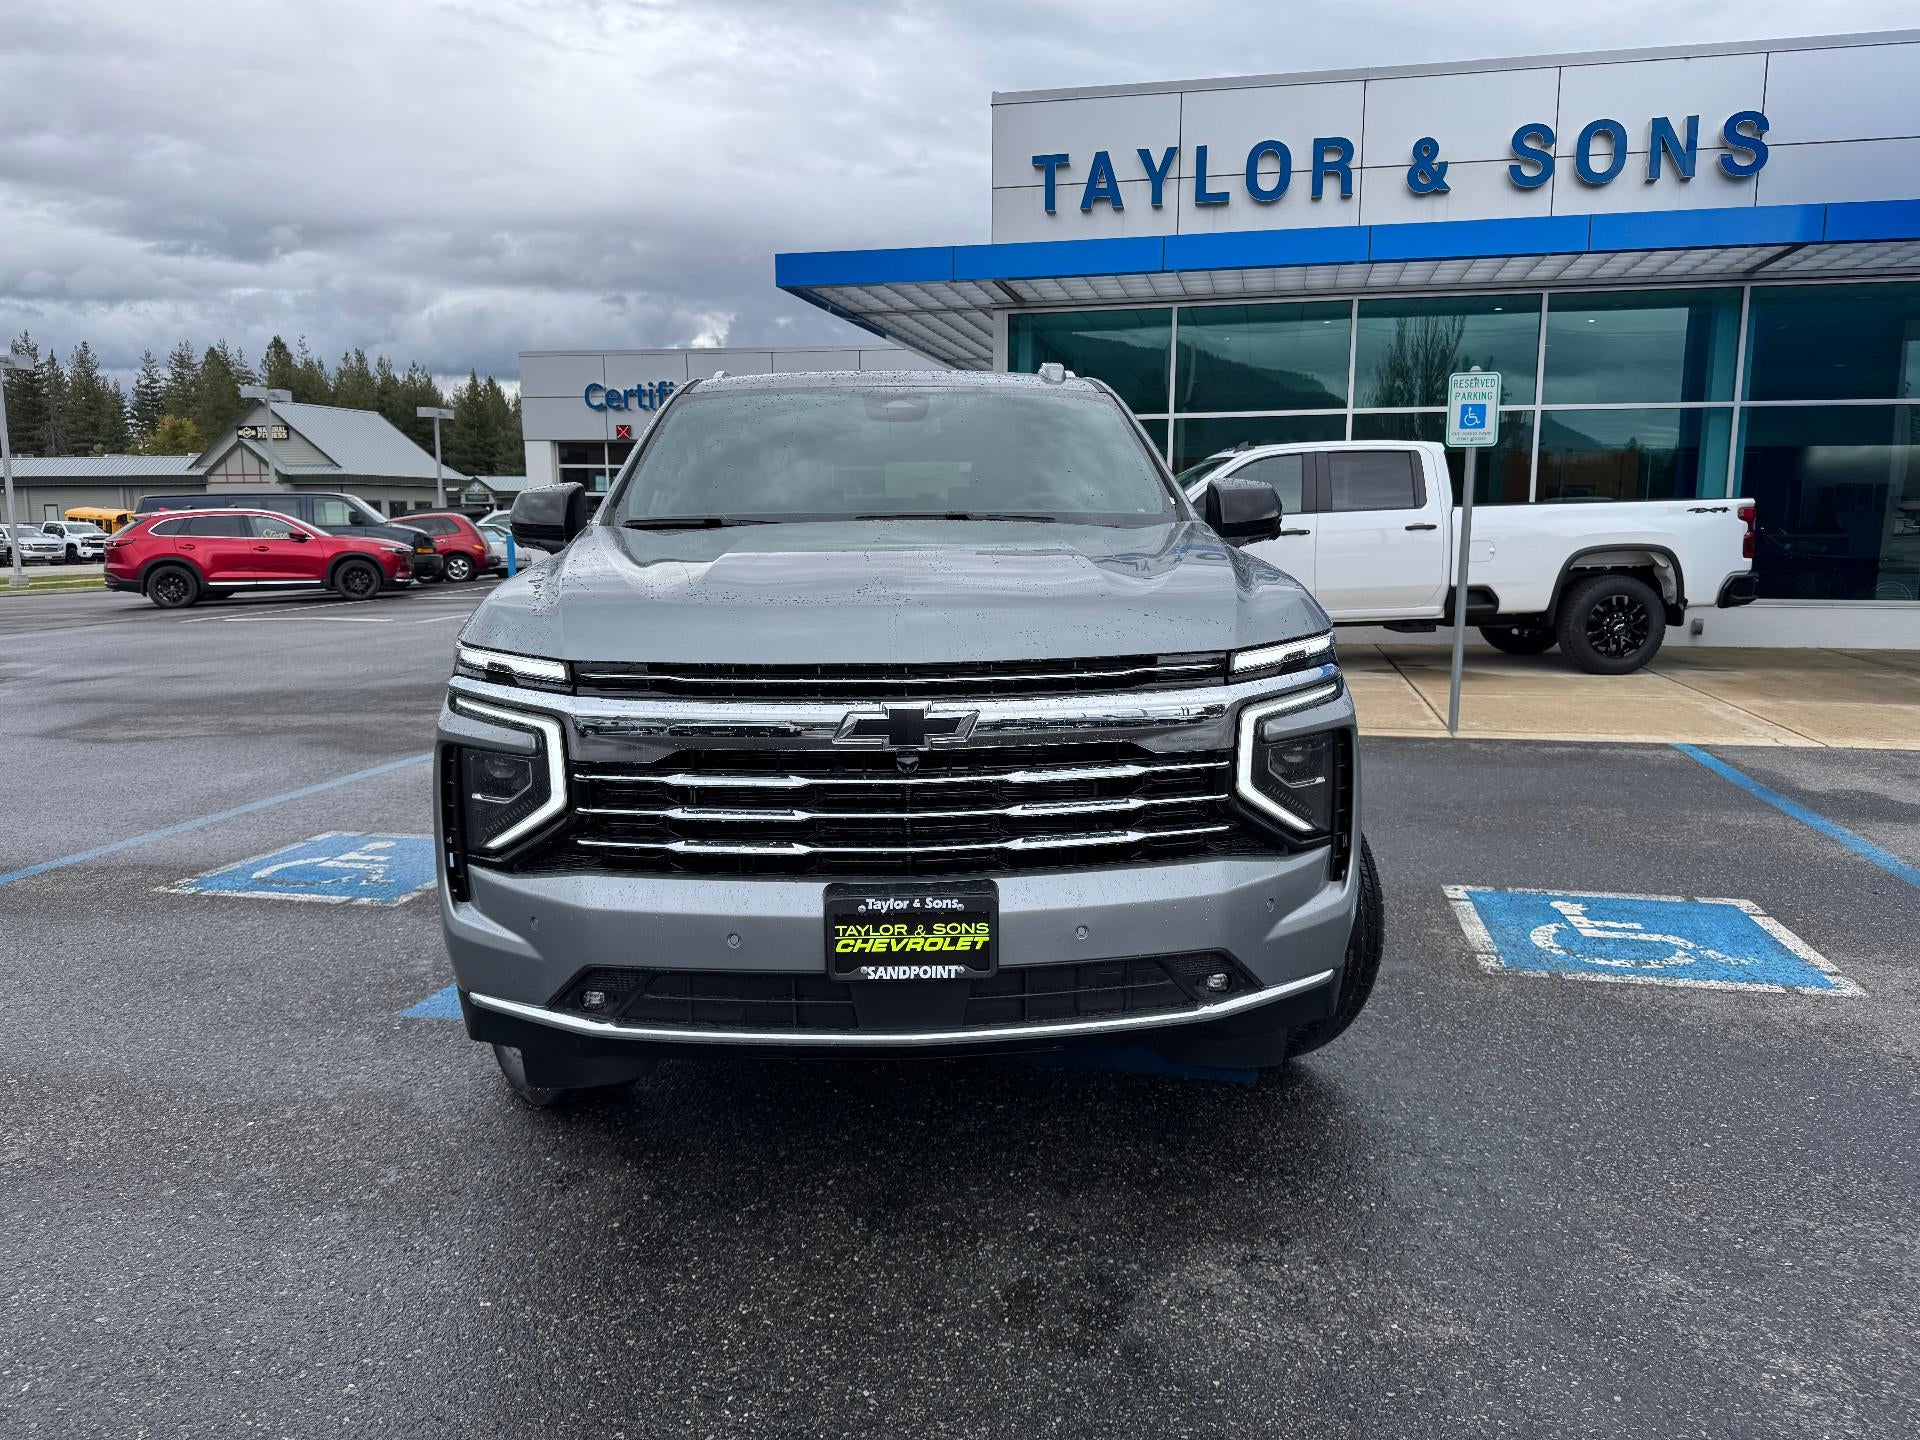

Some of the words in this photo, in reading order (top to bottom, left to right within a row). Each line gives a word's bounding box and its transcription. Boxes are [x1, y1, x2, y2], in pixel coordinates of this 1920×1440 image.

[1032, 136, 1355, 214] TAYLOR
[1406, 137, 1451, 194] &
[1508, 110, 1770, 189] SONS
[1453, 378, 1496, 389] RESERVED
[584, 381, 675, 411] Certifi
[1454, 391, 1493, 401] PARKING
[866, 898, 910, 913] Taylor
[912, 899, 921, 908] &
[925, 897, 959, 909] Sons
[835, 924, 908, 937] TAYLOR
[914, 925, 926, 937] &
[932, 923, 990, 935] SONS
[835, 937, 990, 953] CHEVROLET
[867, 965, 958, 980] SANDPOINT
